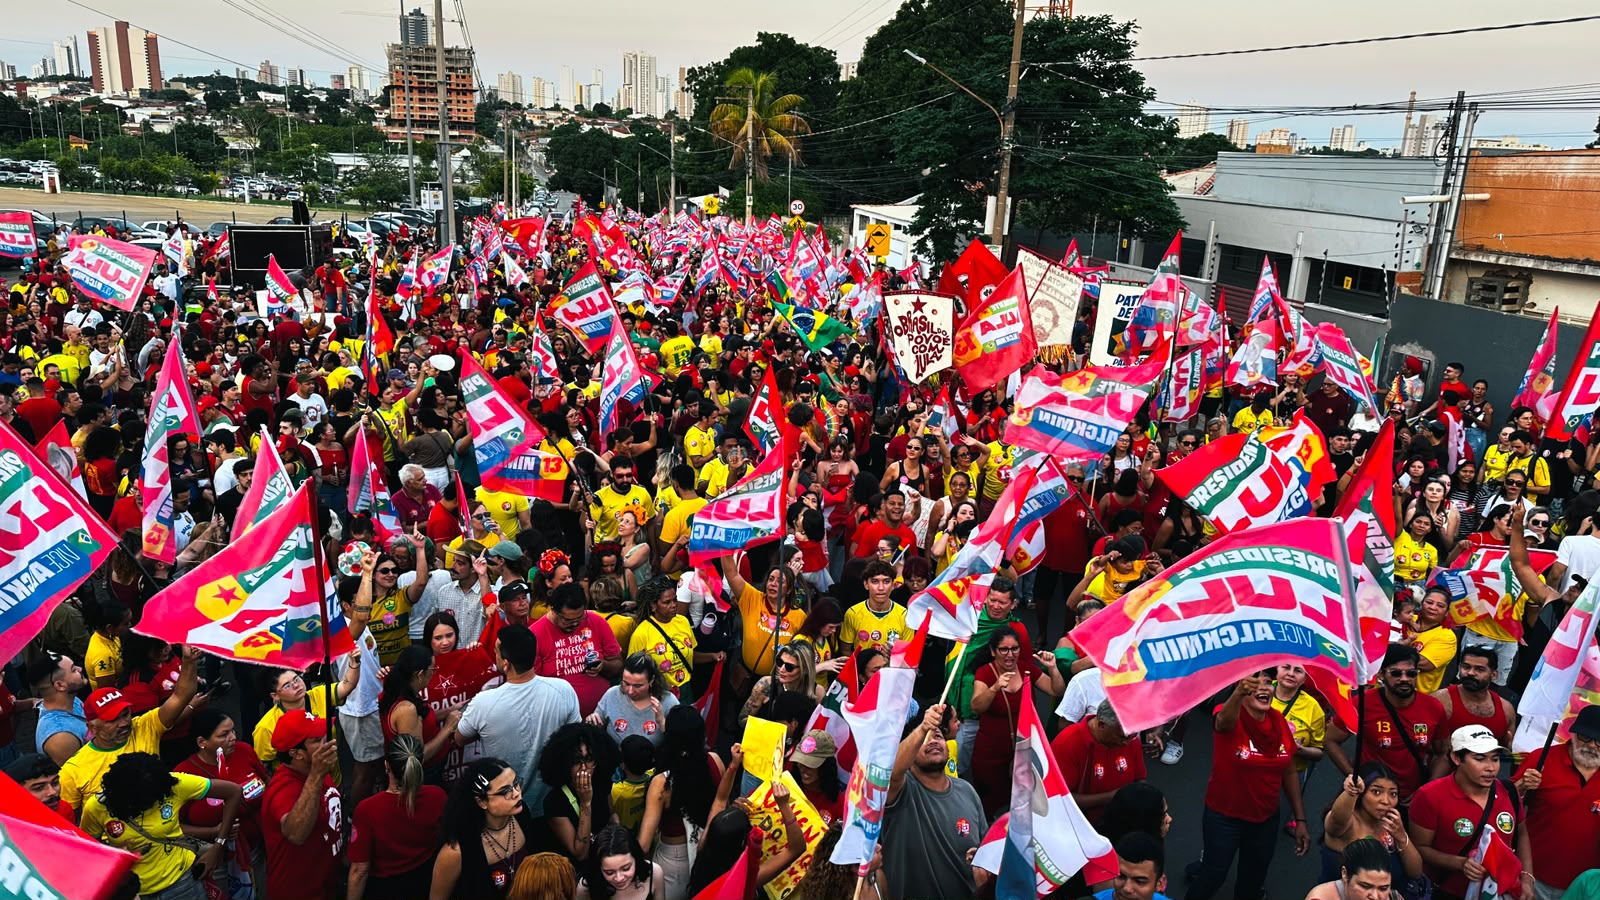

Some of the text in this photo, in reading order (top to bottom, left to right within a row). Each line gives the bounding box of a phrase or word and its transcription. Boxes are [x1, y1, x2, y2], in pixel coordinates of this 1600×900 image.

[1118, 307, 1133, 319] DE
[907, 334, 941, 346] POVO
[542, 457, 563, 473] 13
[441, 680, 451, 689] PT
[95, 690, 123, 707] LULA
[1376, 721, 1391, 733] 13
